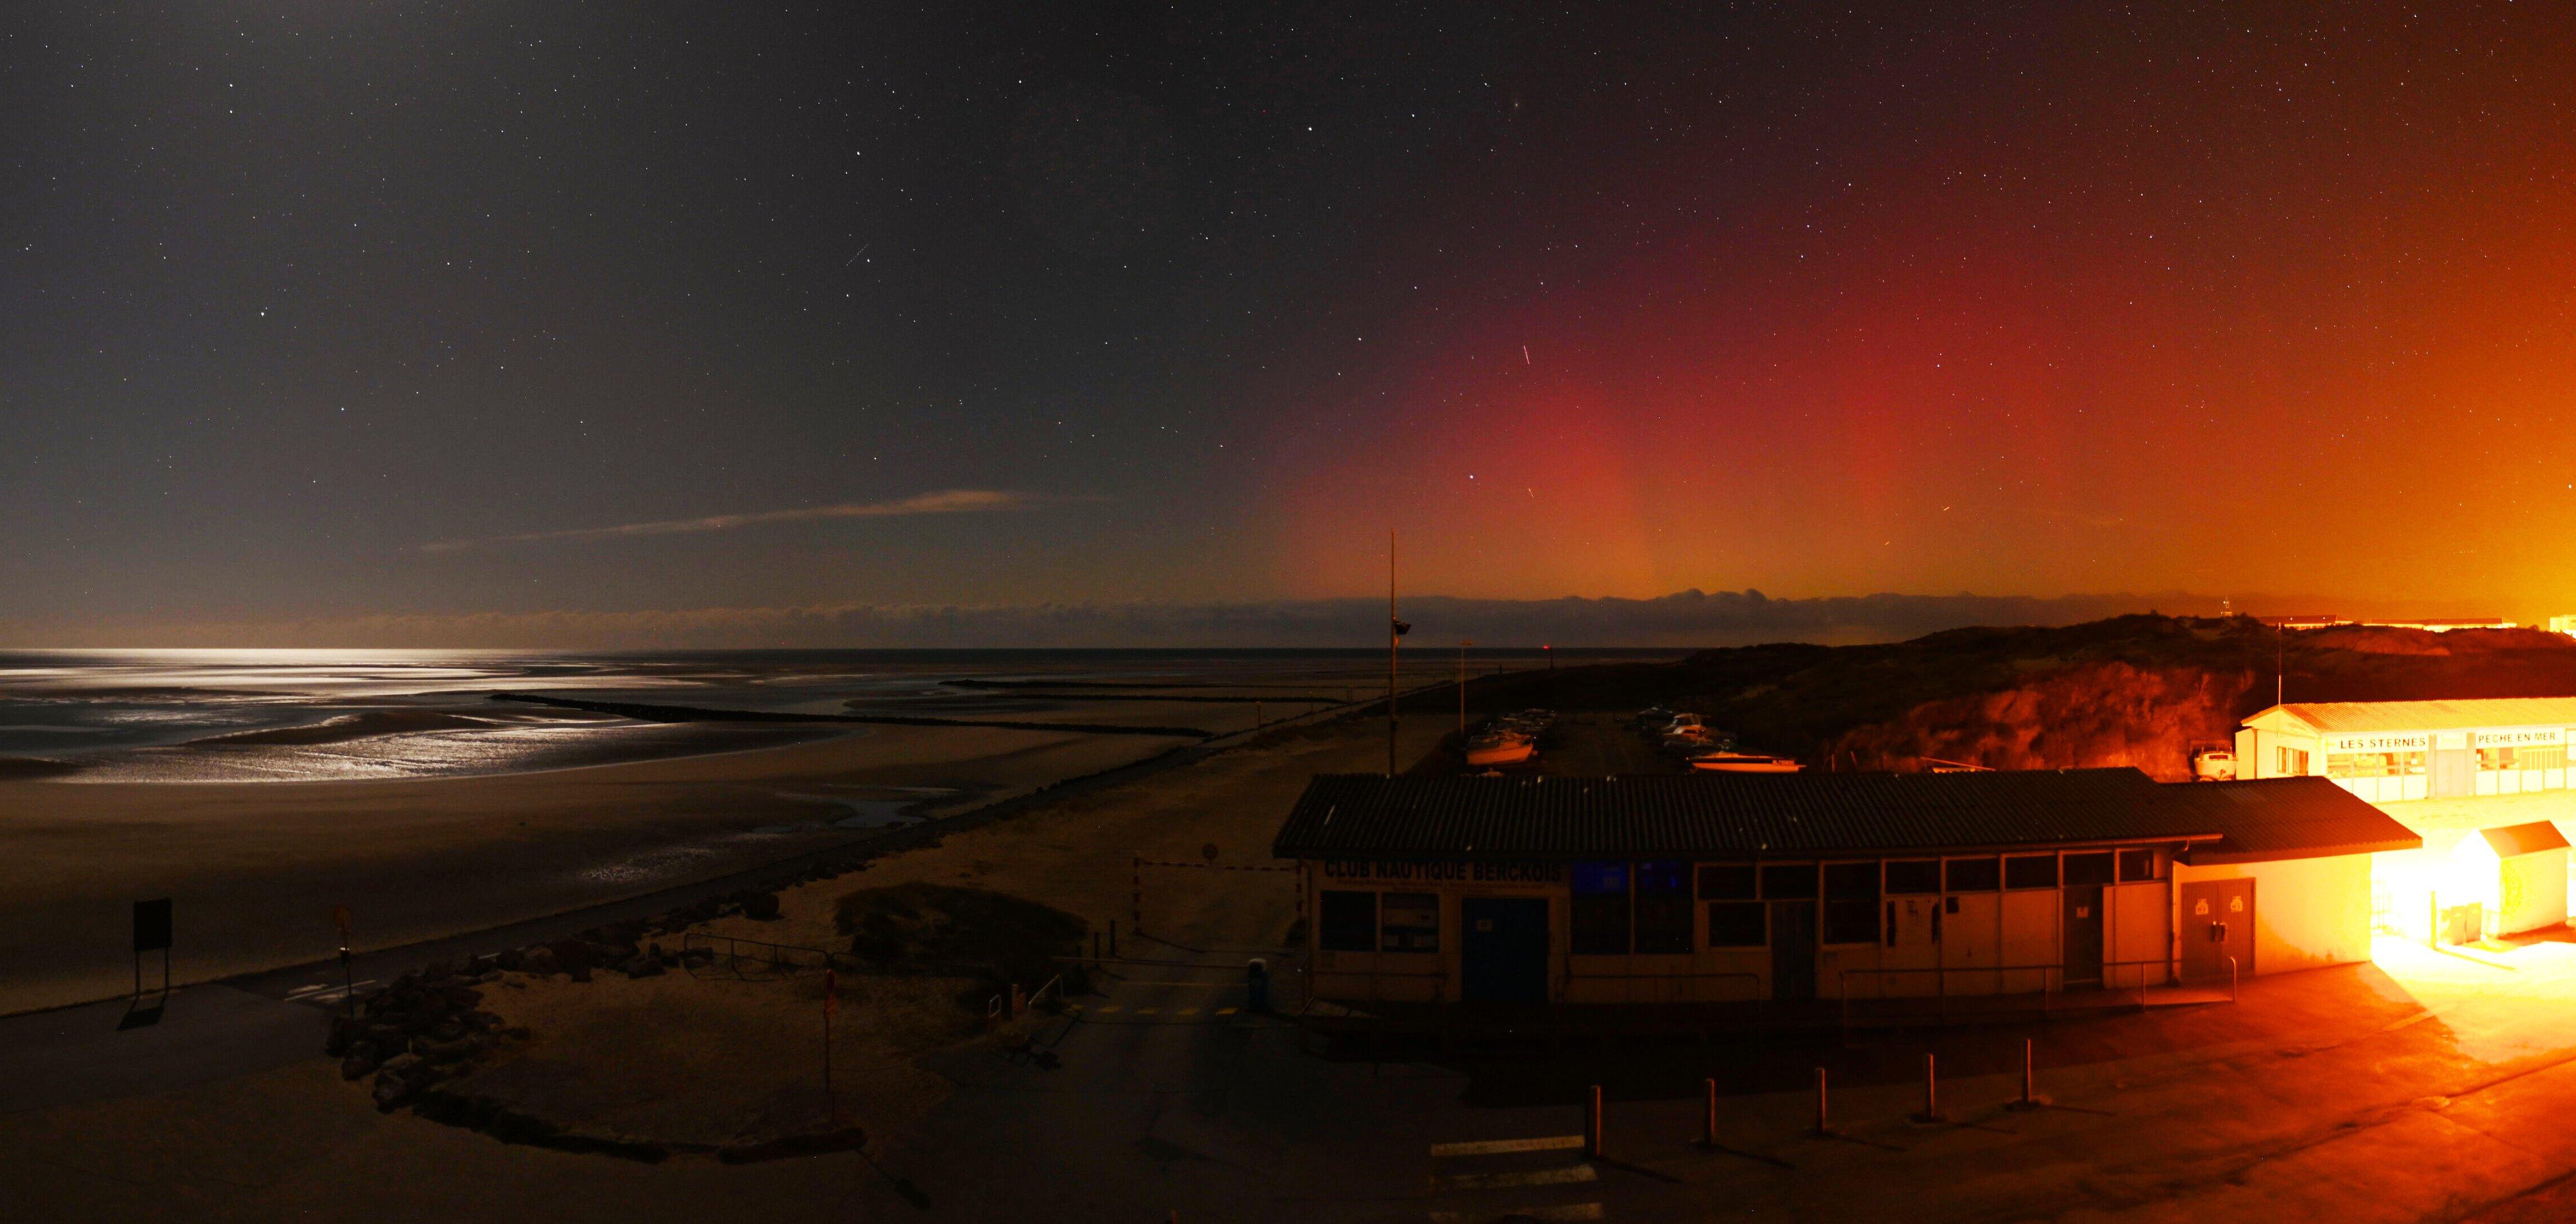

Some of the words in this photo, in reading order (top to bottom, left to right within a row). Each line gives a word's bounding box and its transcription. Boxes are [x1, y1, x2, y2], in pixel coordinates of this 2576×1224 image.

[2341, 740, 2363, 749] LES
[2370, 737, 2426, 748] STERNES
[2479, 734, 2512, 743] PECHE
[2518, 733, 2530, 742] EN
[2534, 732, 2555, 741] MER
[1325, 860, 1370, 877] CLUB
[1376, 860, 1465, 880] NAUTIQUE
[1473, 862, 1561, 882] BERCKOIS
